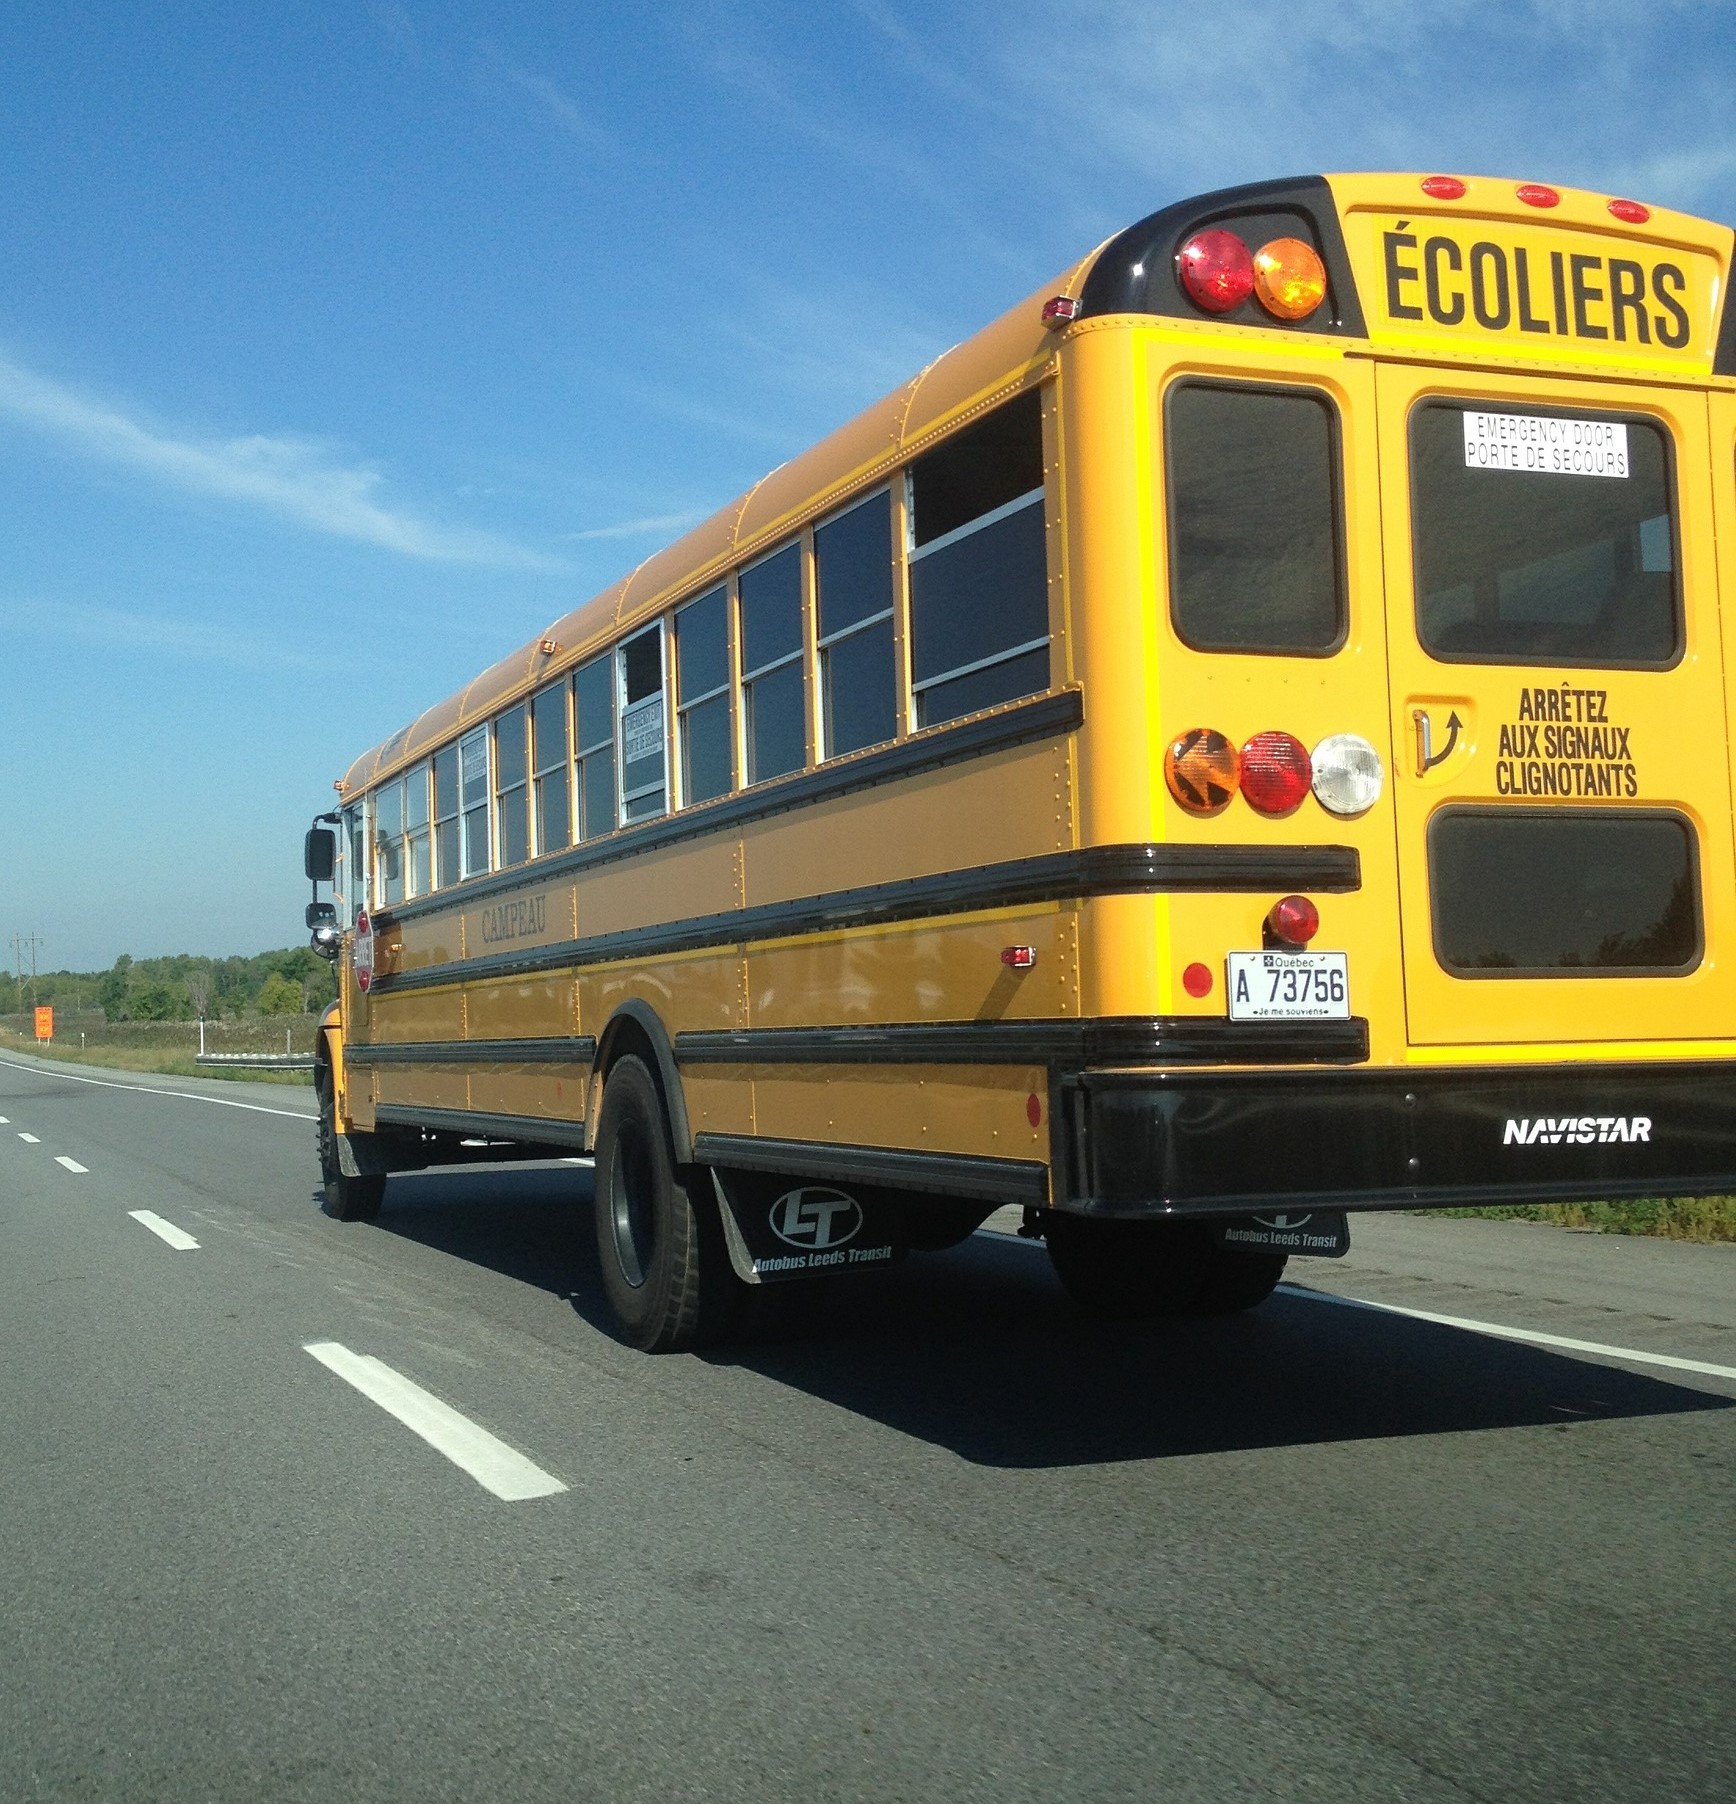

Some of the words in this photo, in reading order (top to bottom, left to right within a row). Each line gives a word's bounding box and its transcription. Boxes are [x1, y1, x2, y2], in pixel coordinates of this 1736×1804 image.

[1383, 221, 1690, 349] ÉCOLIERS
[1477, 416, 1566, 442] EMERGENCY
[1573, 424, 1613, 447] DOOR
[1468, 442, 1519, 467] PORTE
[1526, 447, 1545, 469] DE
[1553, 448, 1626, 474] SECOURS
[1519, 681, 1608, 723] ARRÊTEZ
[1498, 724, 1541, 758] AUX
[1544, 725, 1632, 760] SIGNAUX
[1496, 761, 1638, 797] CLIGNOTANTS
[482, 895, 546, 943] CAMPEAU
[1275, 957, 1314, 967] Québec
[1236, 969, 1250, 1002] A
[1267, 969, 1344, 1002] 73756
[1503, 1117, 1652, 1145] NAVISTAR
[1225, 1228, 1269, 1243] Autobus
[1270, 1232, 1300, 1246] Leeds
[1302, 1233, 1337, 1248] Transit
[754, 1256, 806, 1273] Autobus
[808, 1250, 846, 1267] Leeds
[848, 1245, 892, 1263] Transit
